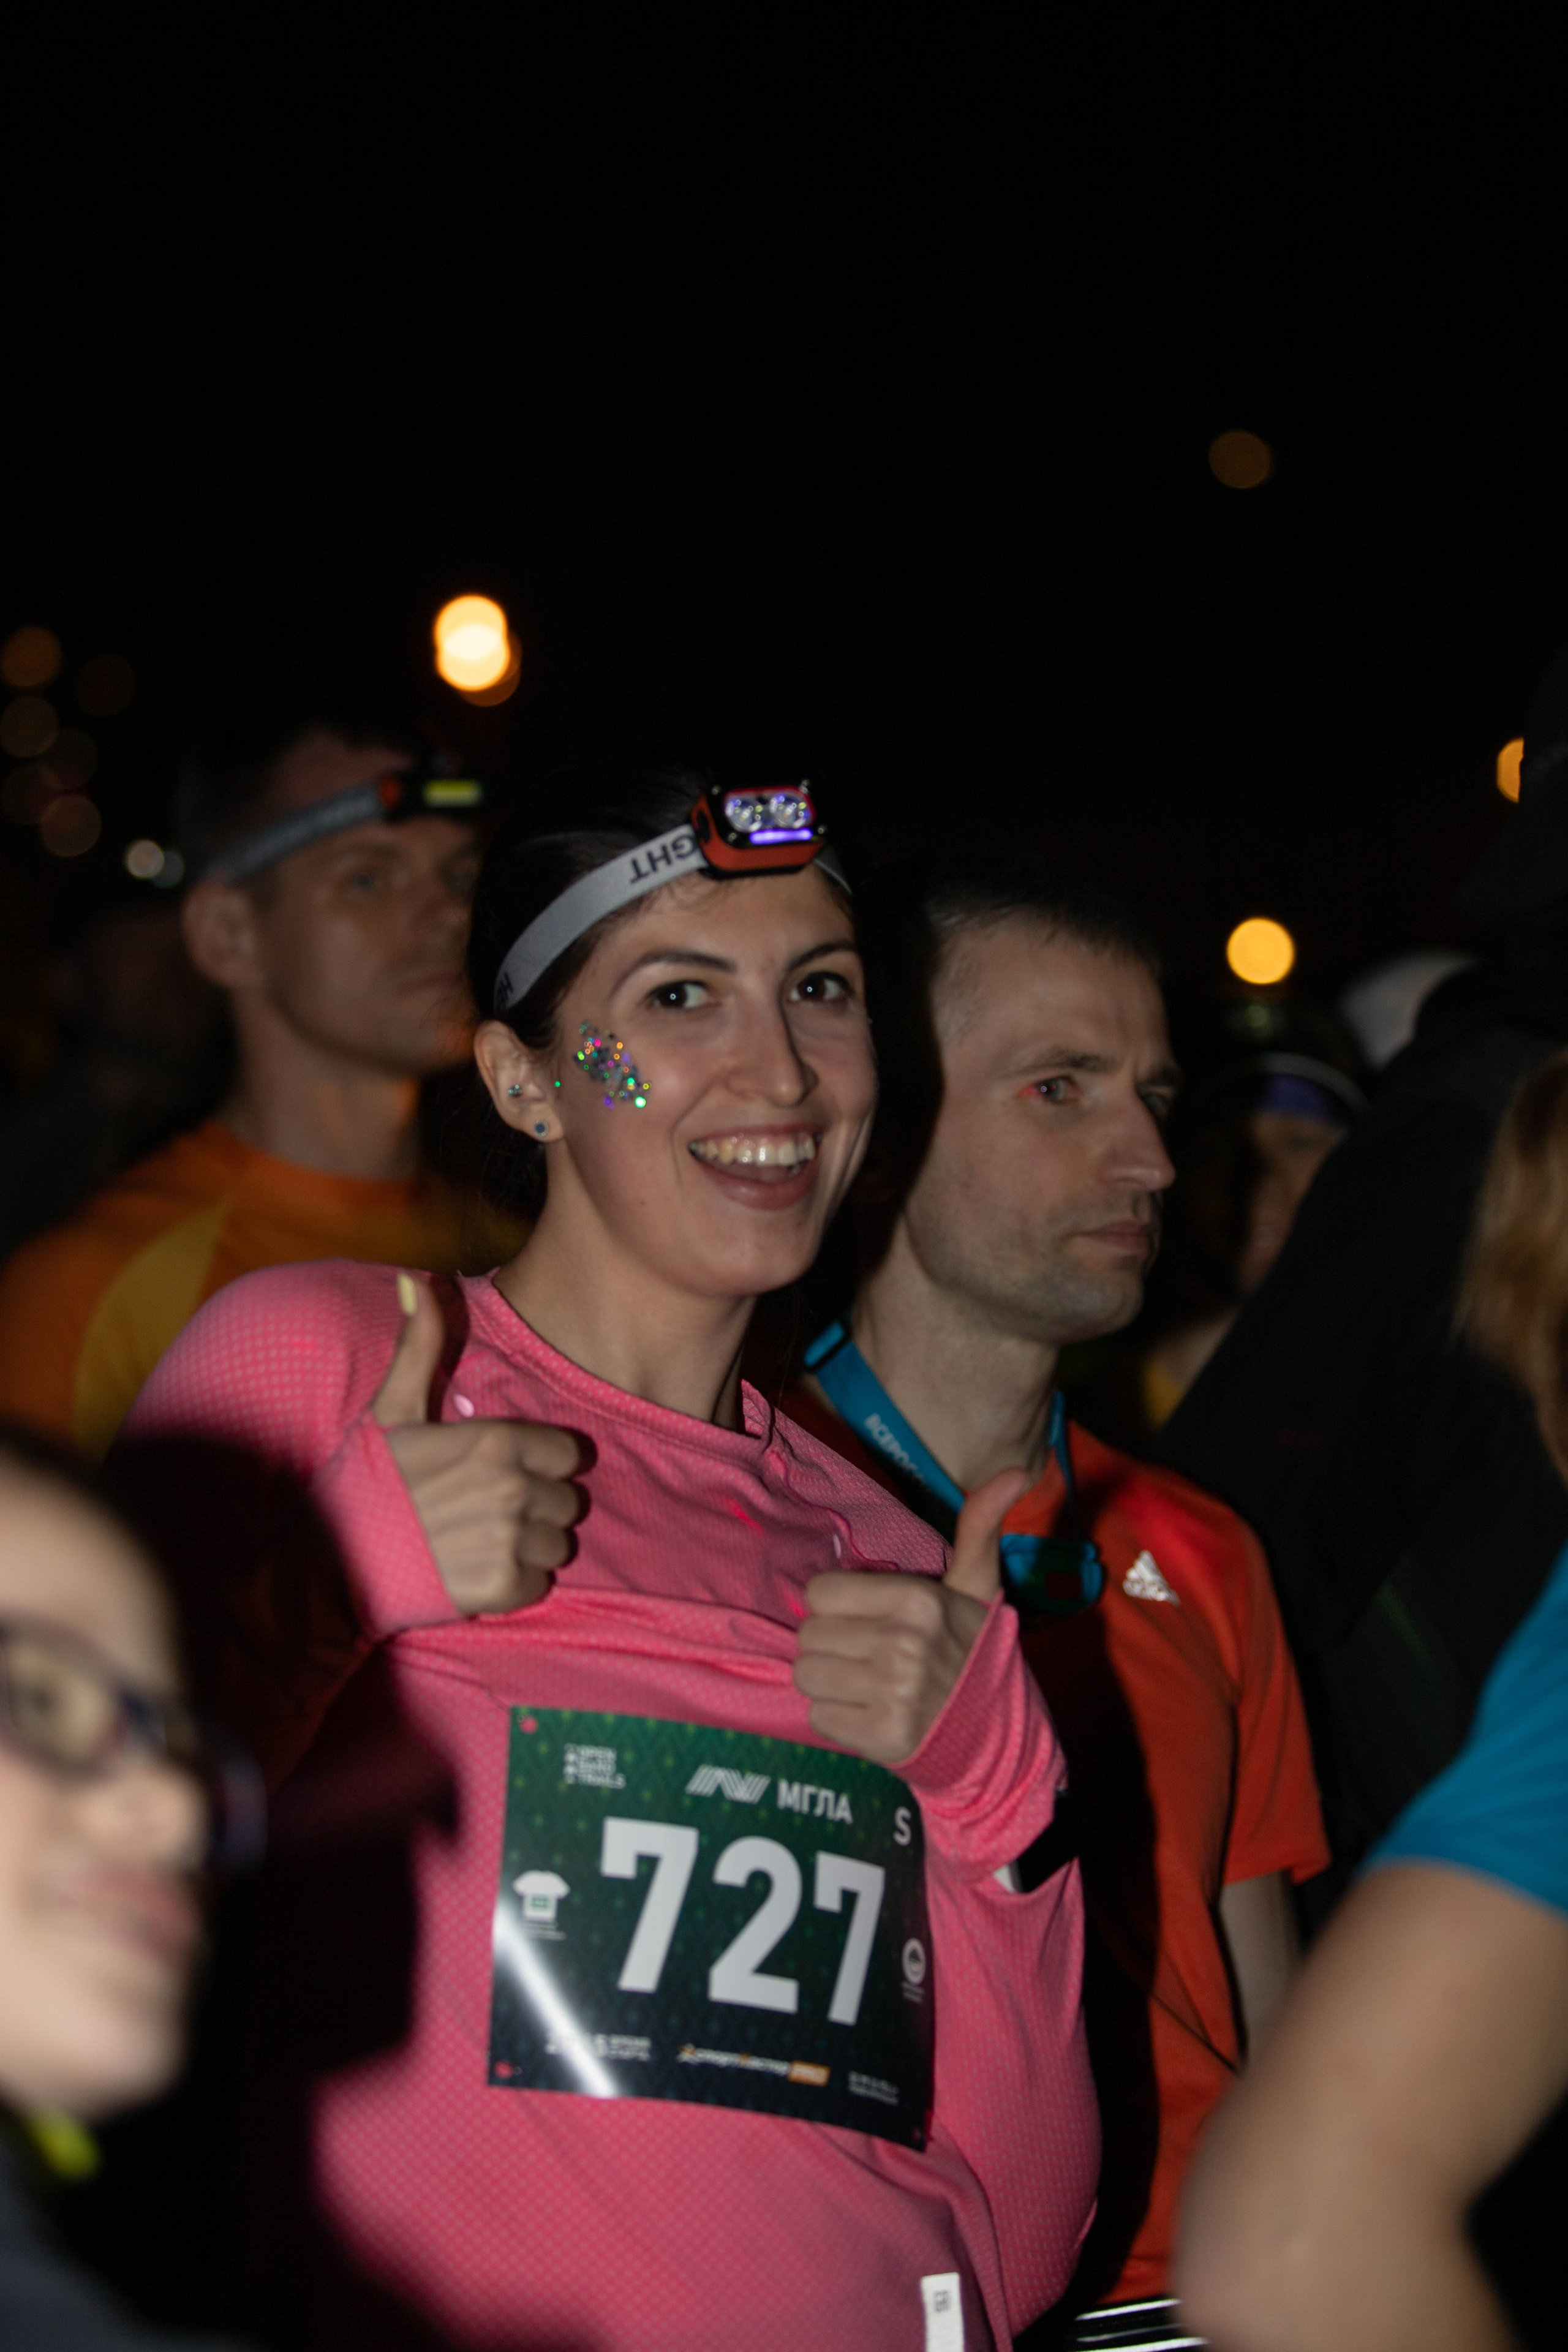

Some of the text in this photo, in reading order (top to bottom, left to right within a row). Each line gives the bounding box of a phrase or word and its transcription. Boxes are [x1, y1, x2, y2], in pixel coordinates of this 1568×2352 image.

[777, 1778, 853, 1825] МГЛА
[893, 1807, 911, 1846] S
[600, 1815, 886, 2026] 727
